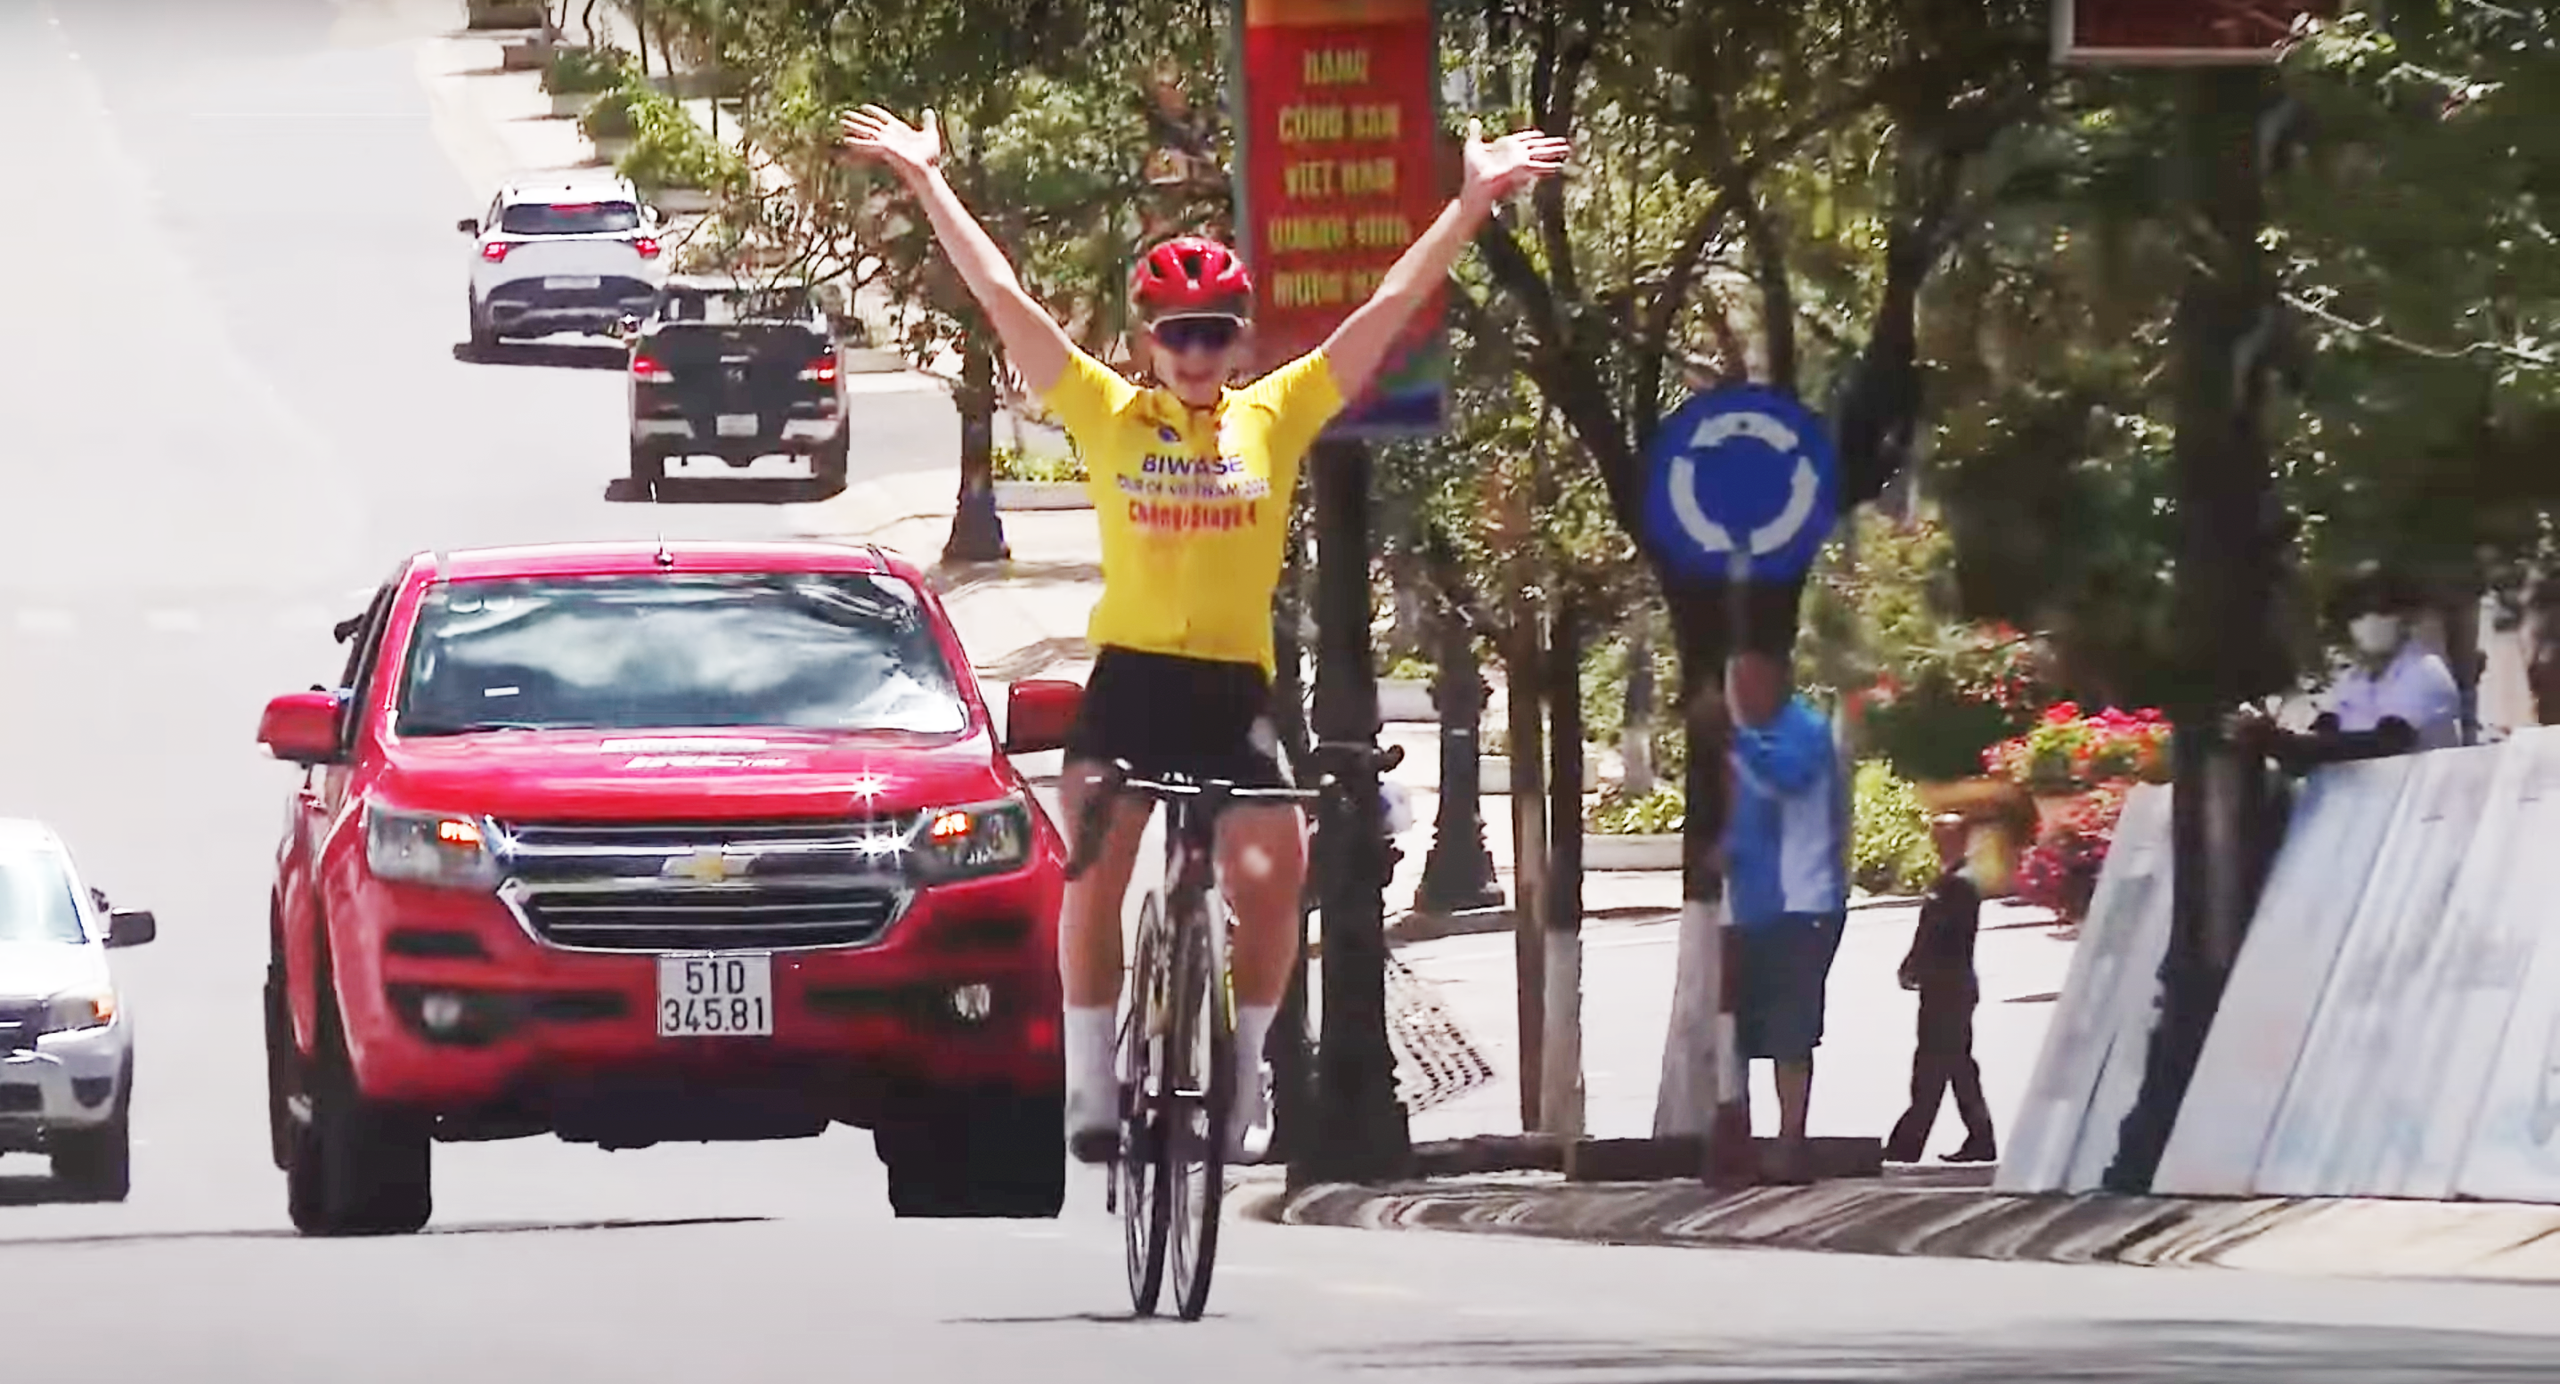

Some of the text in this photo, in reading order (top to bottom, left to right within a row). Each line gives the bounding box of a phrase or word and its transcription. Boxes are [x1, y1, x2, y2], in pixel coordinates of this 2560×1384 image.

[1142, 453, 1245, 475] BIWASE
[685, 961, 745, 994] 51D
[664, 997, 764, 1032] 345.81
